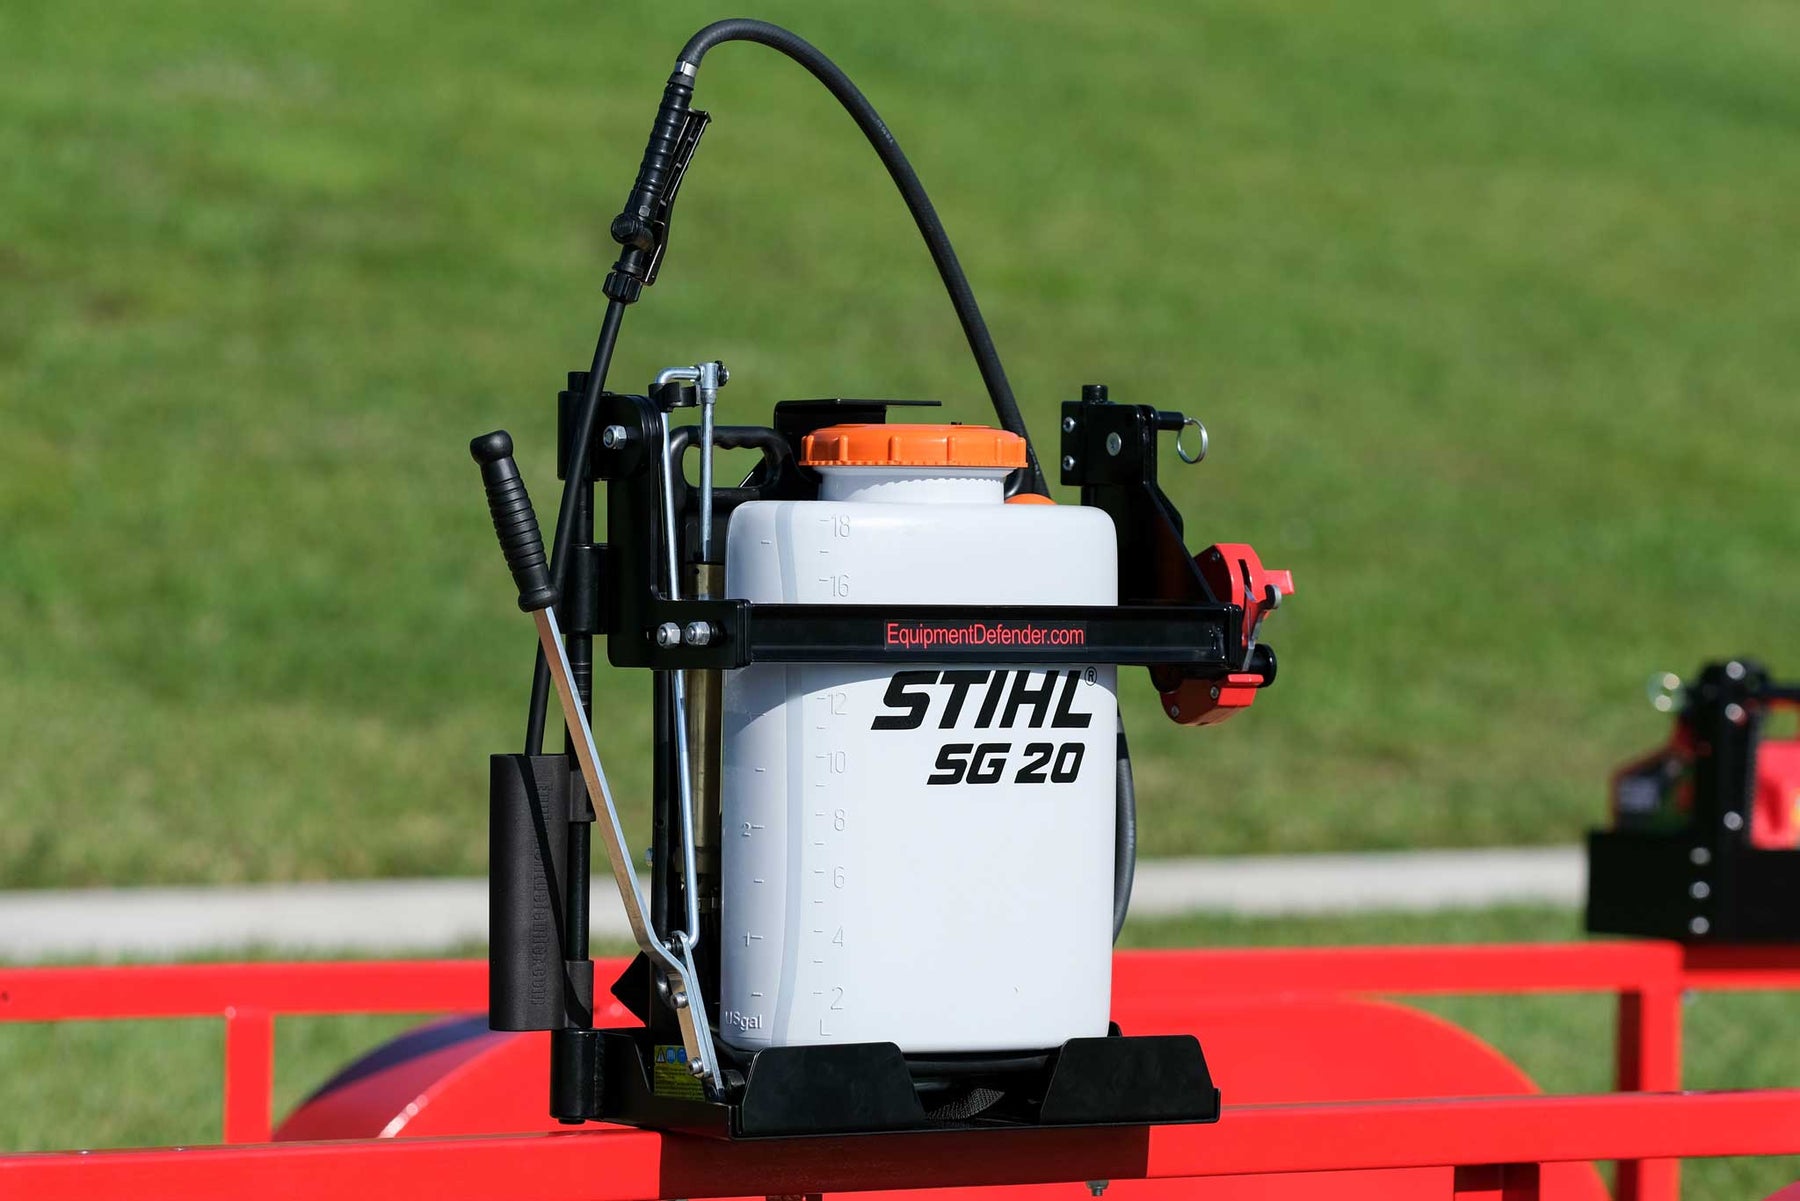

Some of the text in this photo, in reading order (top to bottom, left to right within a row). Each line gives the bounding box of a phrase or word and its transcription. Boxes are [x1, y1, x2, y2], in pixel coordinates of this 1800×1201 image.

[831, 514, 850, 537] 18
[830, 574, 849, 597] 16
[887, 623, 1084, 649] EquipmentDefender.com
[828, 693, 848, 715] 12
[827, 751, 846, 774] 10
[927, 742, 1086, 785] SG 20
[834, 808, 845, 831] 8
[833, 866, 845, 888] 6
[832, 925, 843, 947] 4
[830, 986, 843, 1010] 2
